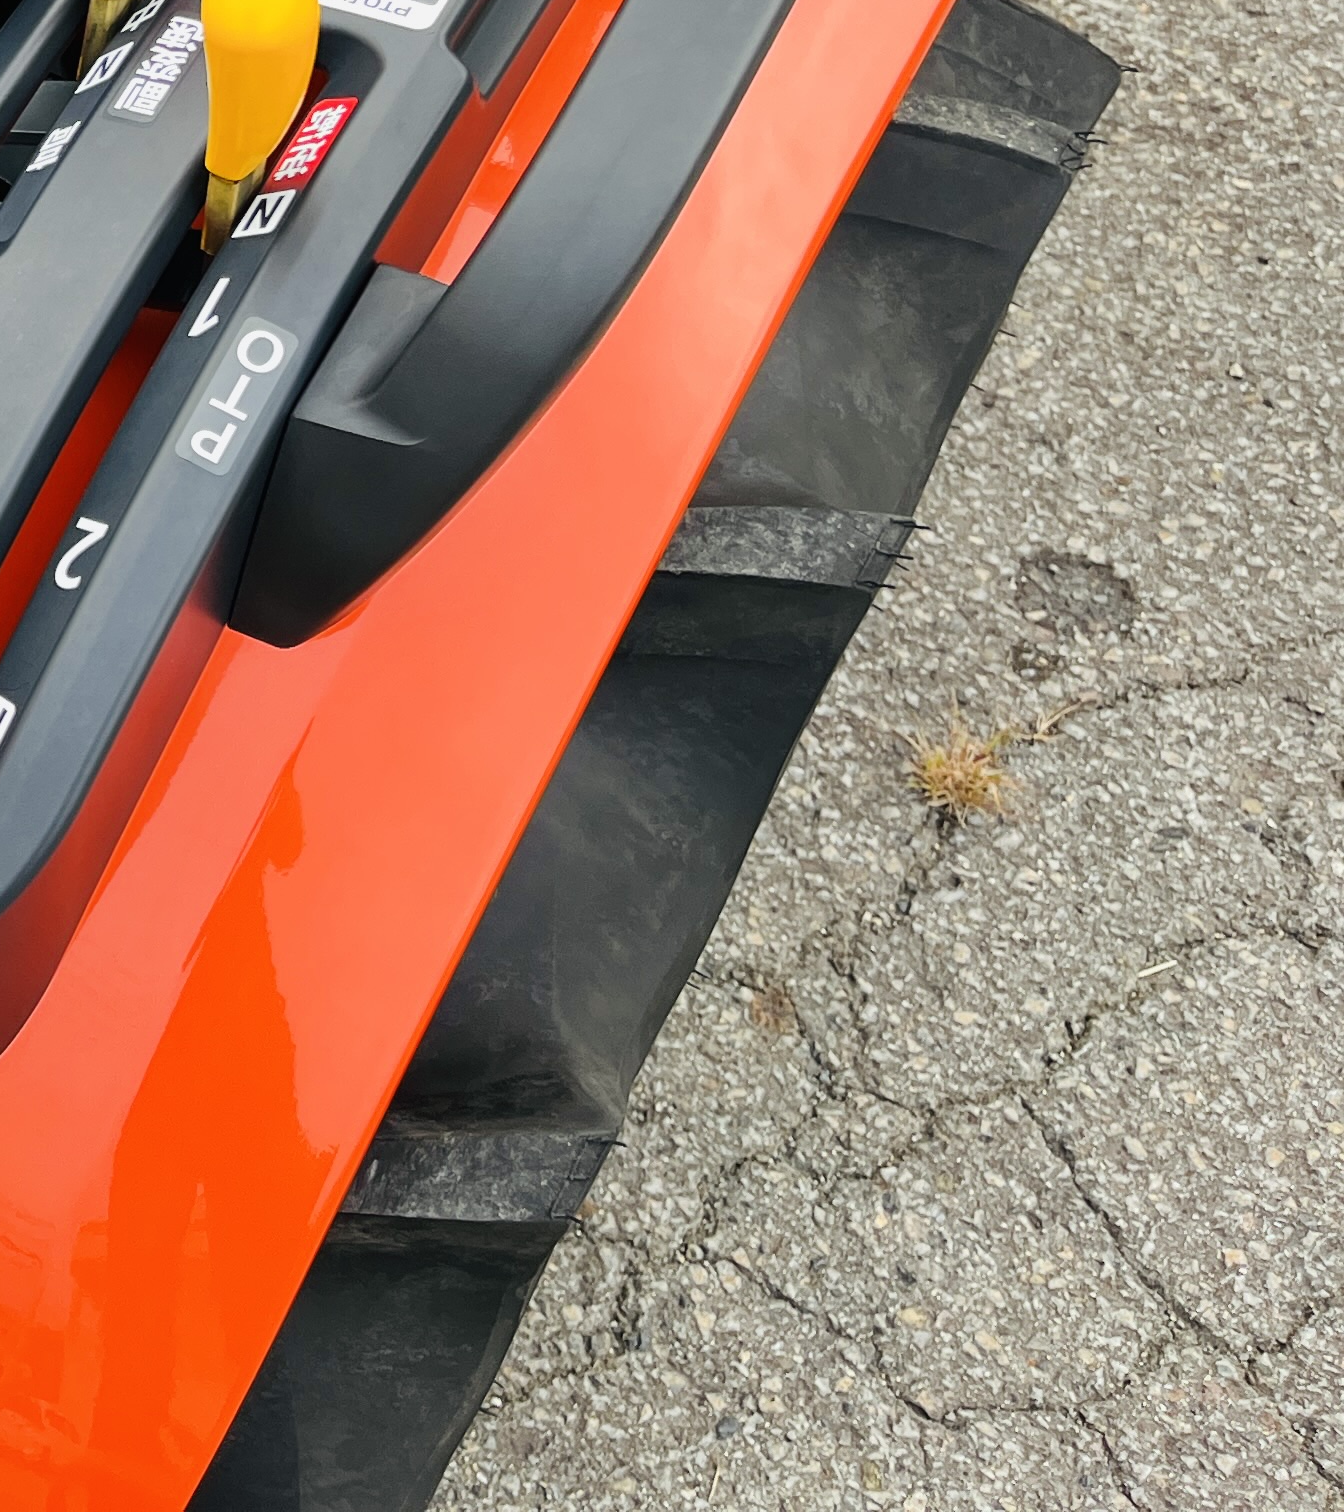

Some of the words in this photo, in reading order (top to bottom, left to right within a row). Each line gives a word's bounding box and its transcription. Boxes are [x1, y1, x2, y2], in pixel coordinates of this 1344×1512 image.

[274, 103, 347, 181] 逆転
[186, 277, 231, 338] 1
[189, 329, 284, 465] PTO
[53, 516, 110, 591] 2
